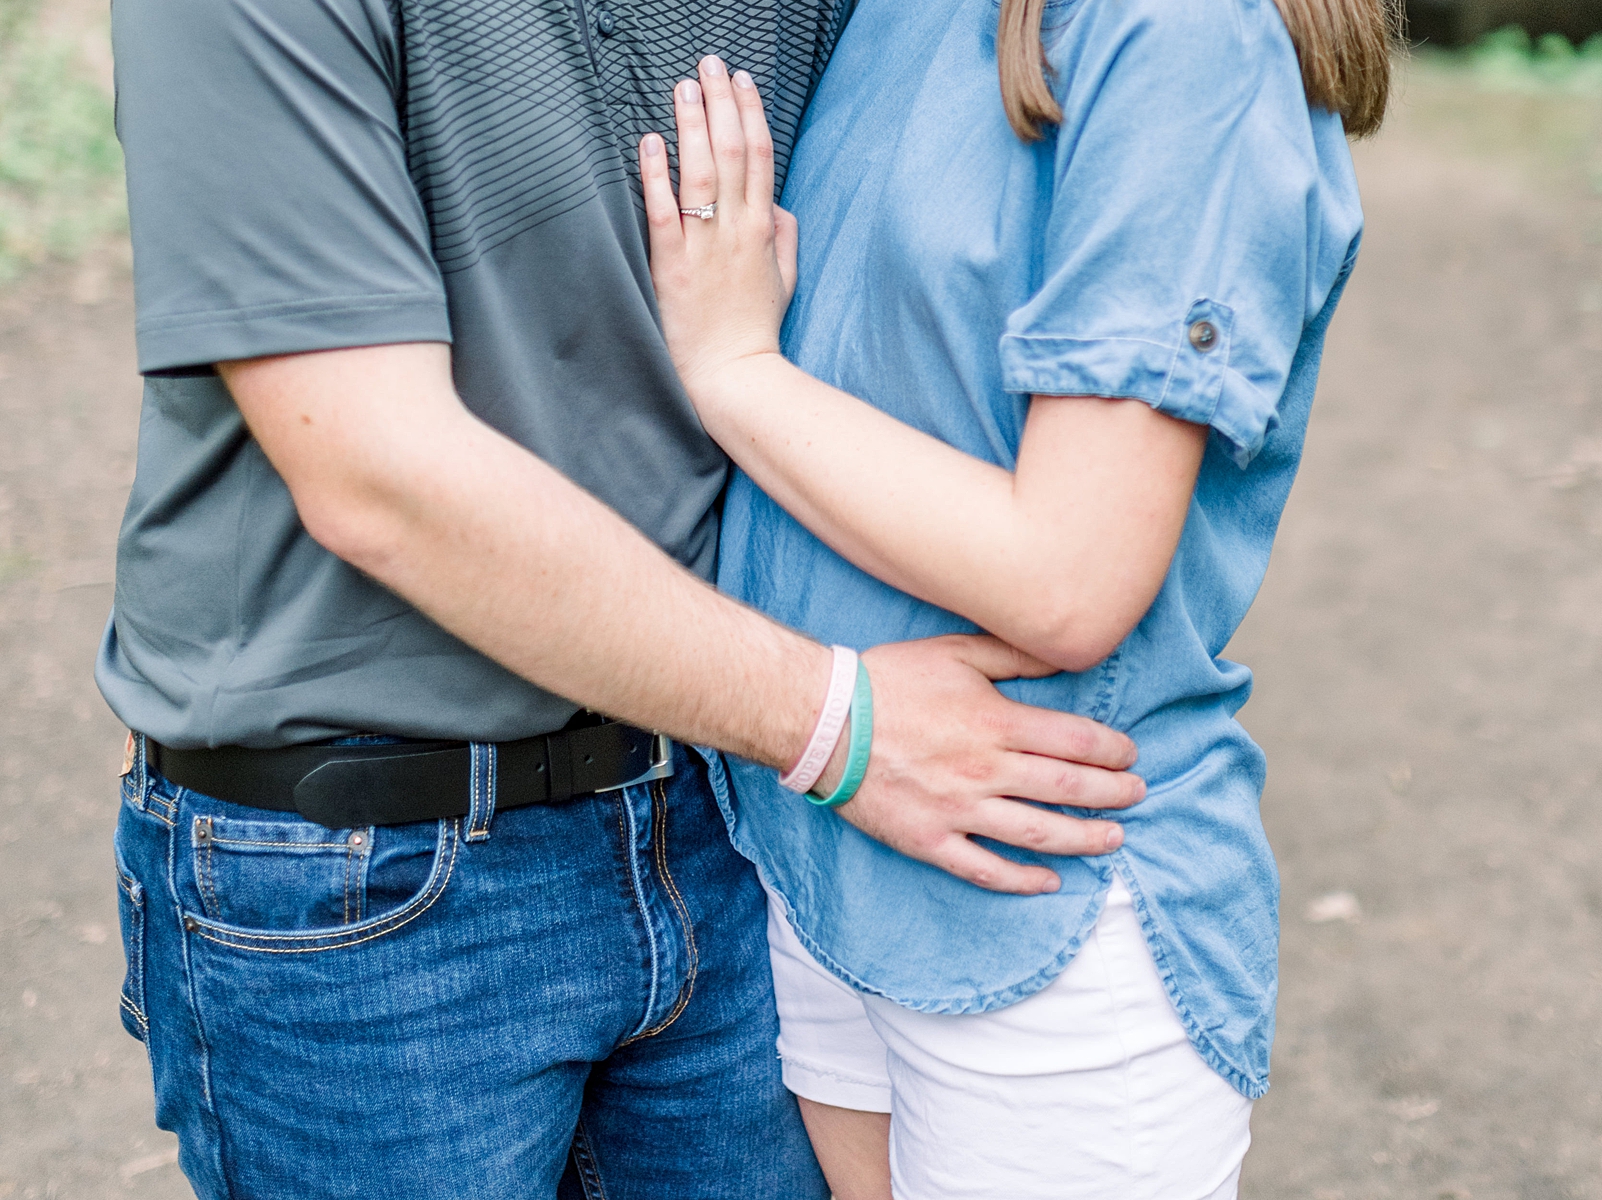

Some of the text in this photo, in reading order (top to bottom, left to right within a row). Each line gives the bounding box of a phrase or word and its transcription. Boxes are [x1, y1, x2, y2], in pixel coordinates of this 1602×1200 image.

[859, 706, 871, 744] TEAL
[787, 748, 825, 791] HOPE
[852, 748, 868, 779] FOR
